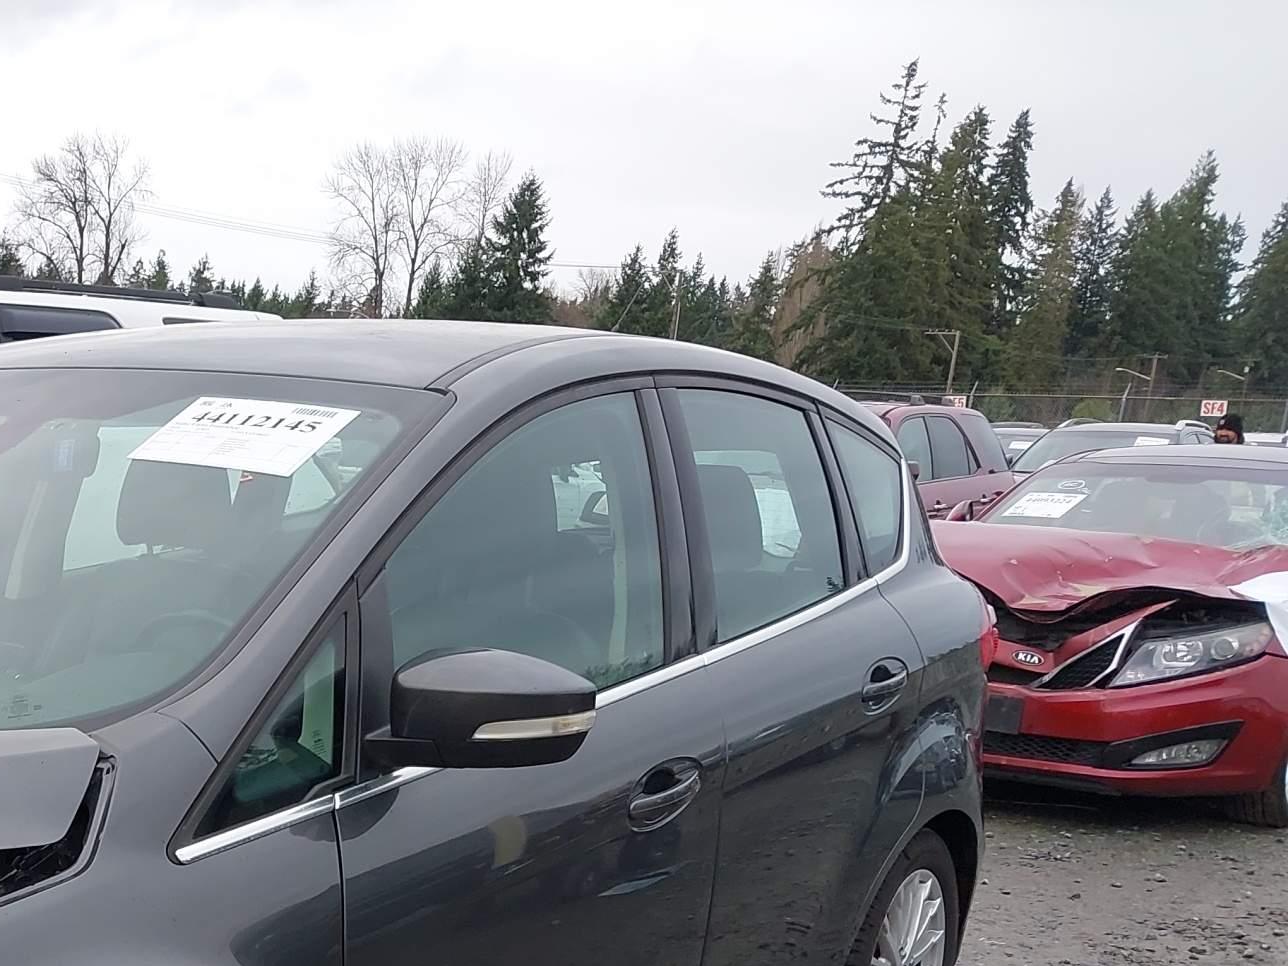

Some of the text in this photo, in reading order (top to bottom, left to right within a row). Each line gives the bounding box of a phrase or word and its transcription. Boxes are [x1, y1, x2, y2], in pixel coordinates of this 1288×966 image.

[1202, 401, 1225, 415] SF4
[191, 410, 323, 434] 44112145
[1017, 652, 1039, 664] KIA
